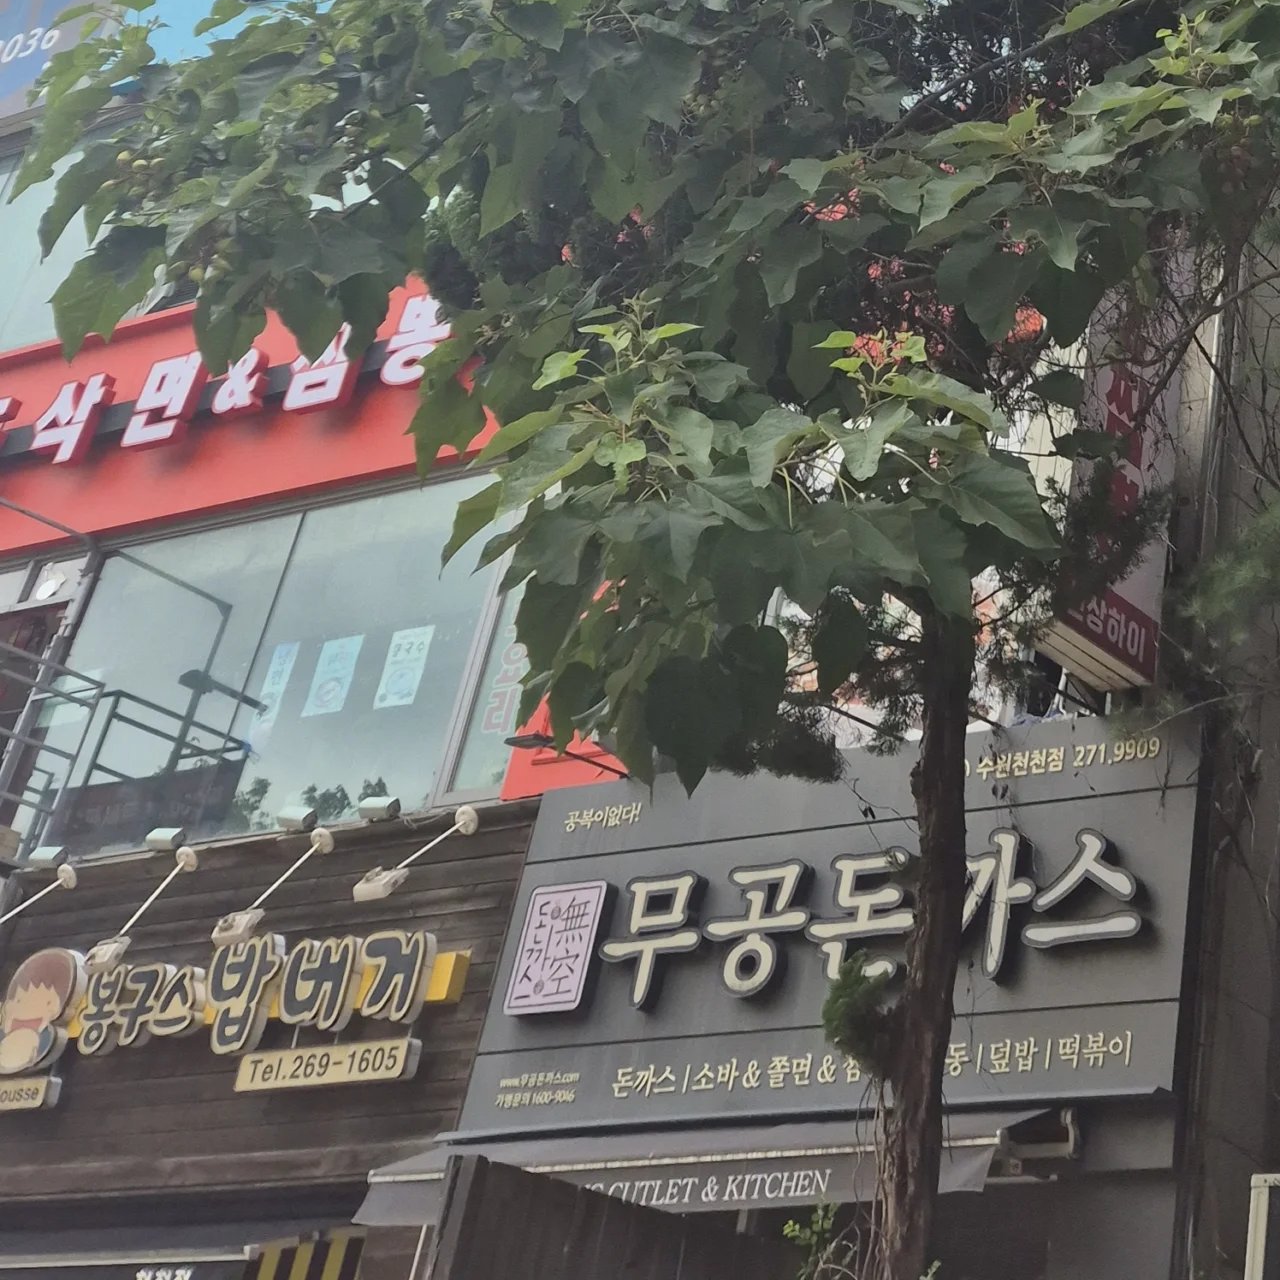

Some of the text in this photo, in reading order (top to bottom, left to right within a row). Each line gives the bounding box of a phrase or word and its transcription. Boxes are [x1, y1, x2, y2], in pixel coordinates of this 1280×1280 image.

[976, 747, 1065, 780] 수원천천점
[1073, 737, 1161, 767] 271.9909
[211, 933, 422, 1052] 밥버거
[249, 1046, 400, 1084] Tel.269-1605
[989, 1036, 1039, 1075] 덮밥
[1058, 1030, 1132, 1069] 떡볶이
[612, 1063, 676, 1099] 돈까스
[692, 1058, 740, 1092] 소바
[701, 1175, 719, 1202] &
[723, 1169, 832, 1201] KITCHEN
